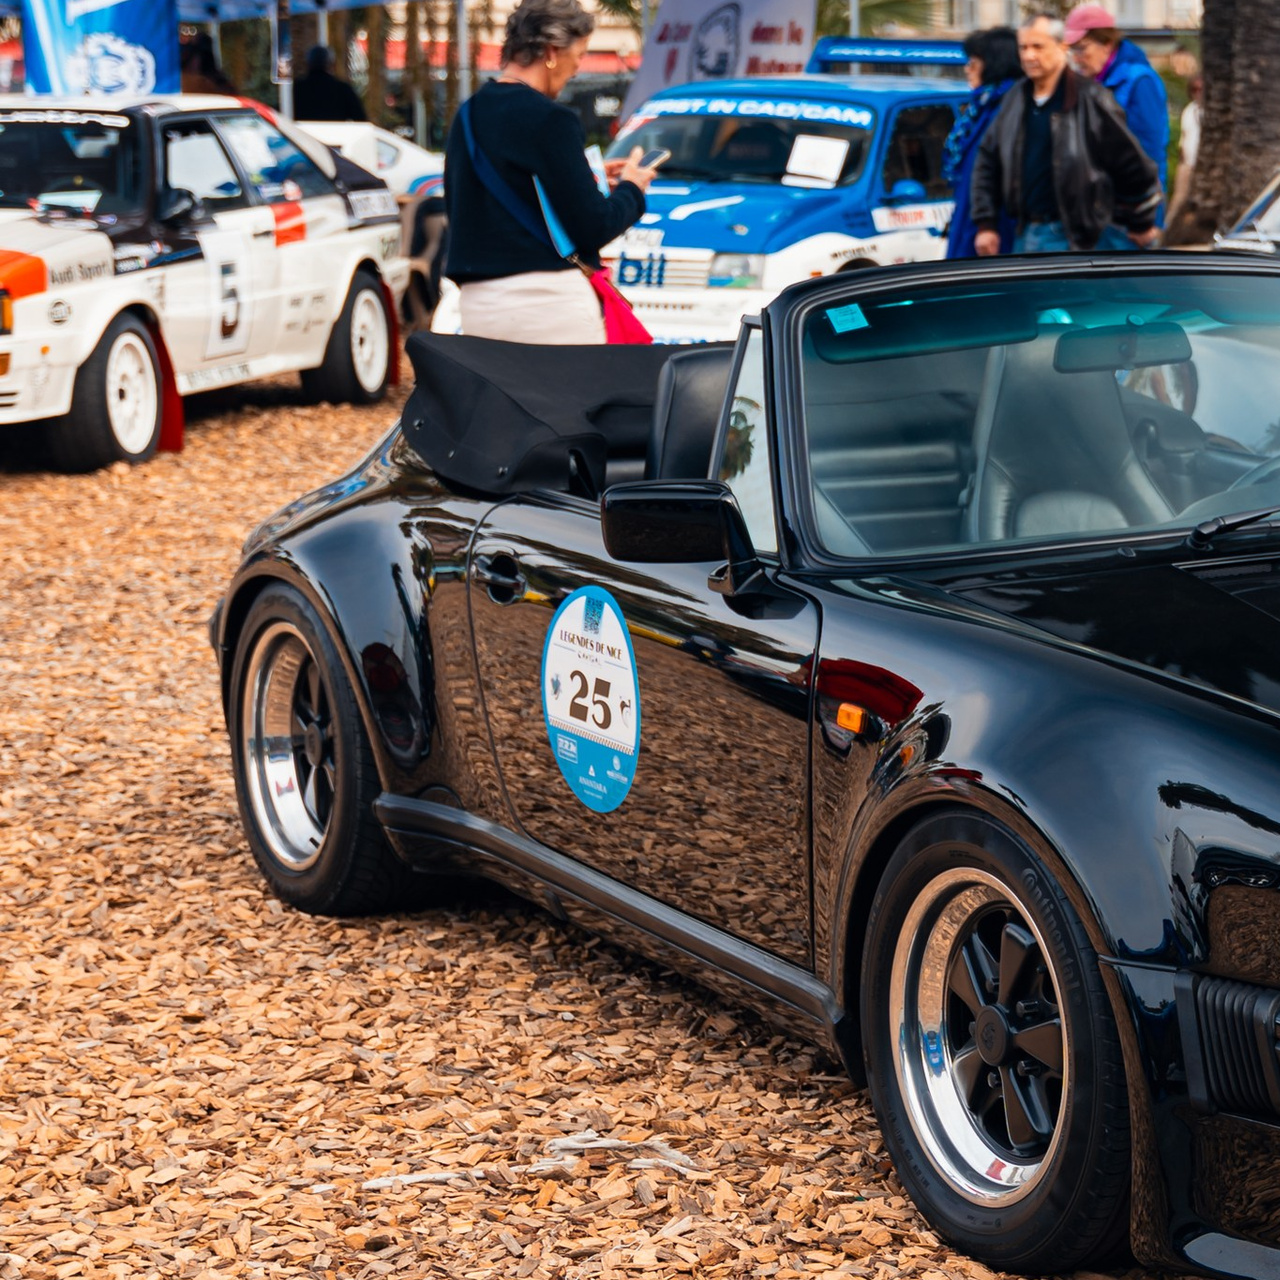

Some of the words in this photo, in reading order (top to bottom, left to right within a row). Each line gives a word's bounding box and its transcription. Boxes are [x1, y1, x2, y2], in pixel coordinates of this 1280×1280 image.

[707, 100, 737, 114] IN
[738, 100, 873, 126] CAD/CAM
[220, 262, 240, 340] 5
[560, 629, 595, 651] LEGENDES
[595, 641, 605, 655] DE
[606, 645, 622, 660] NICE
[569, 669, 612, 730] 25
[1021, 867, 1081, 990] Continental
